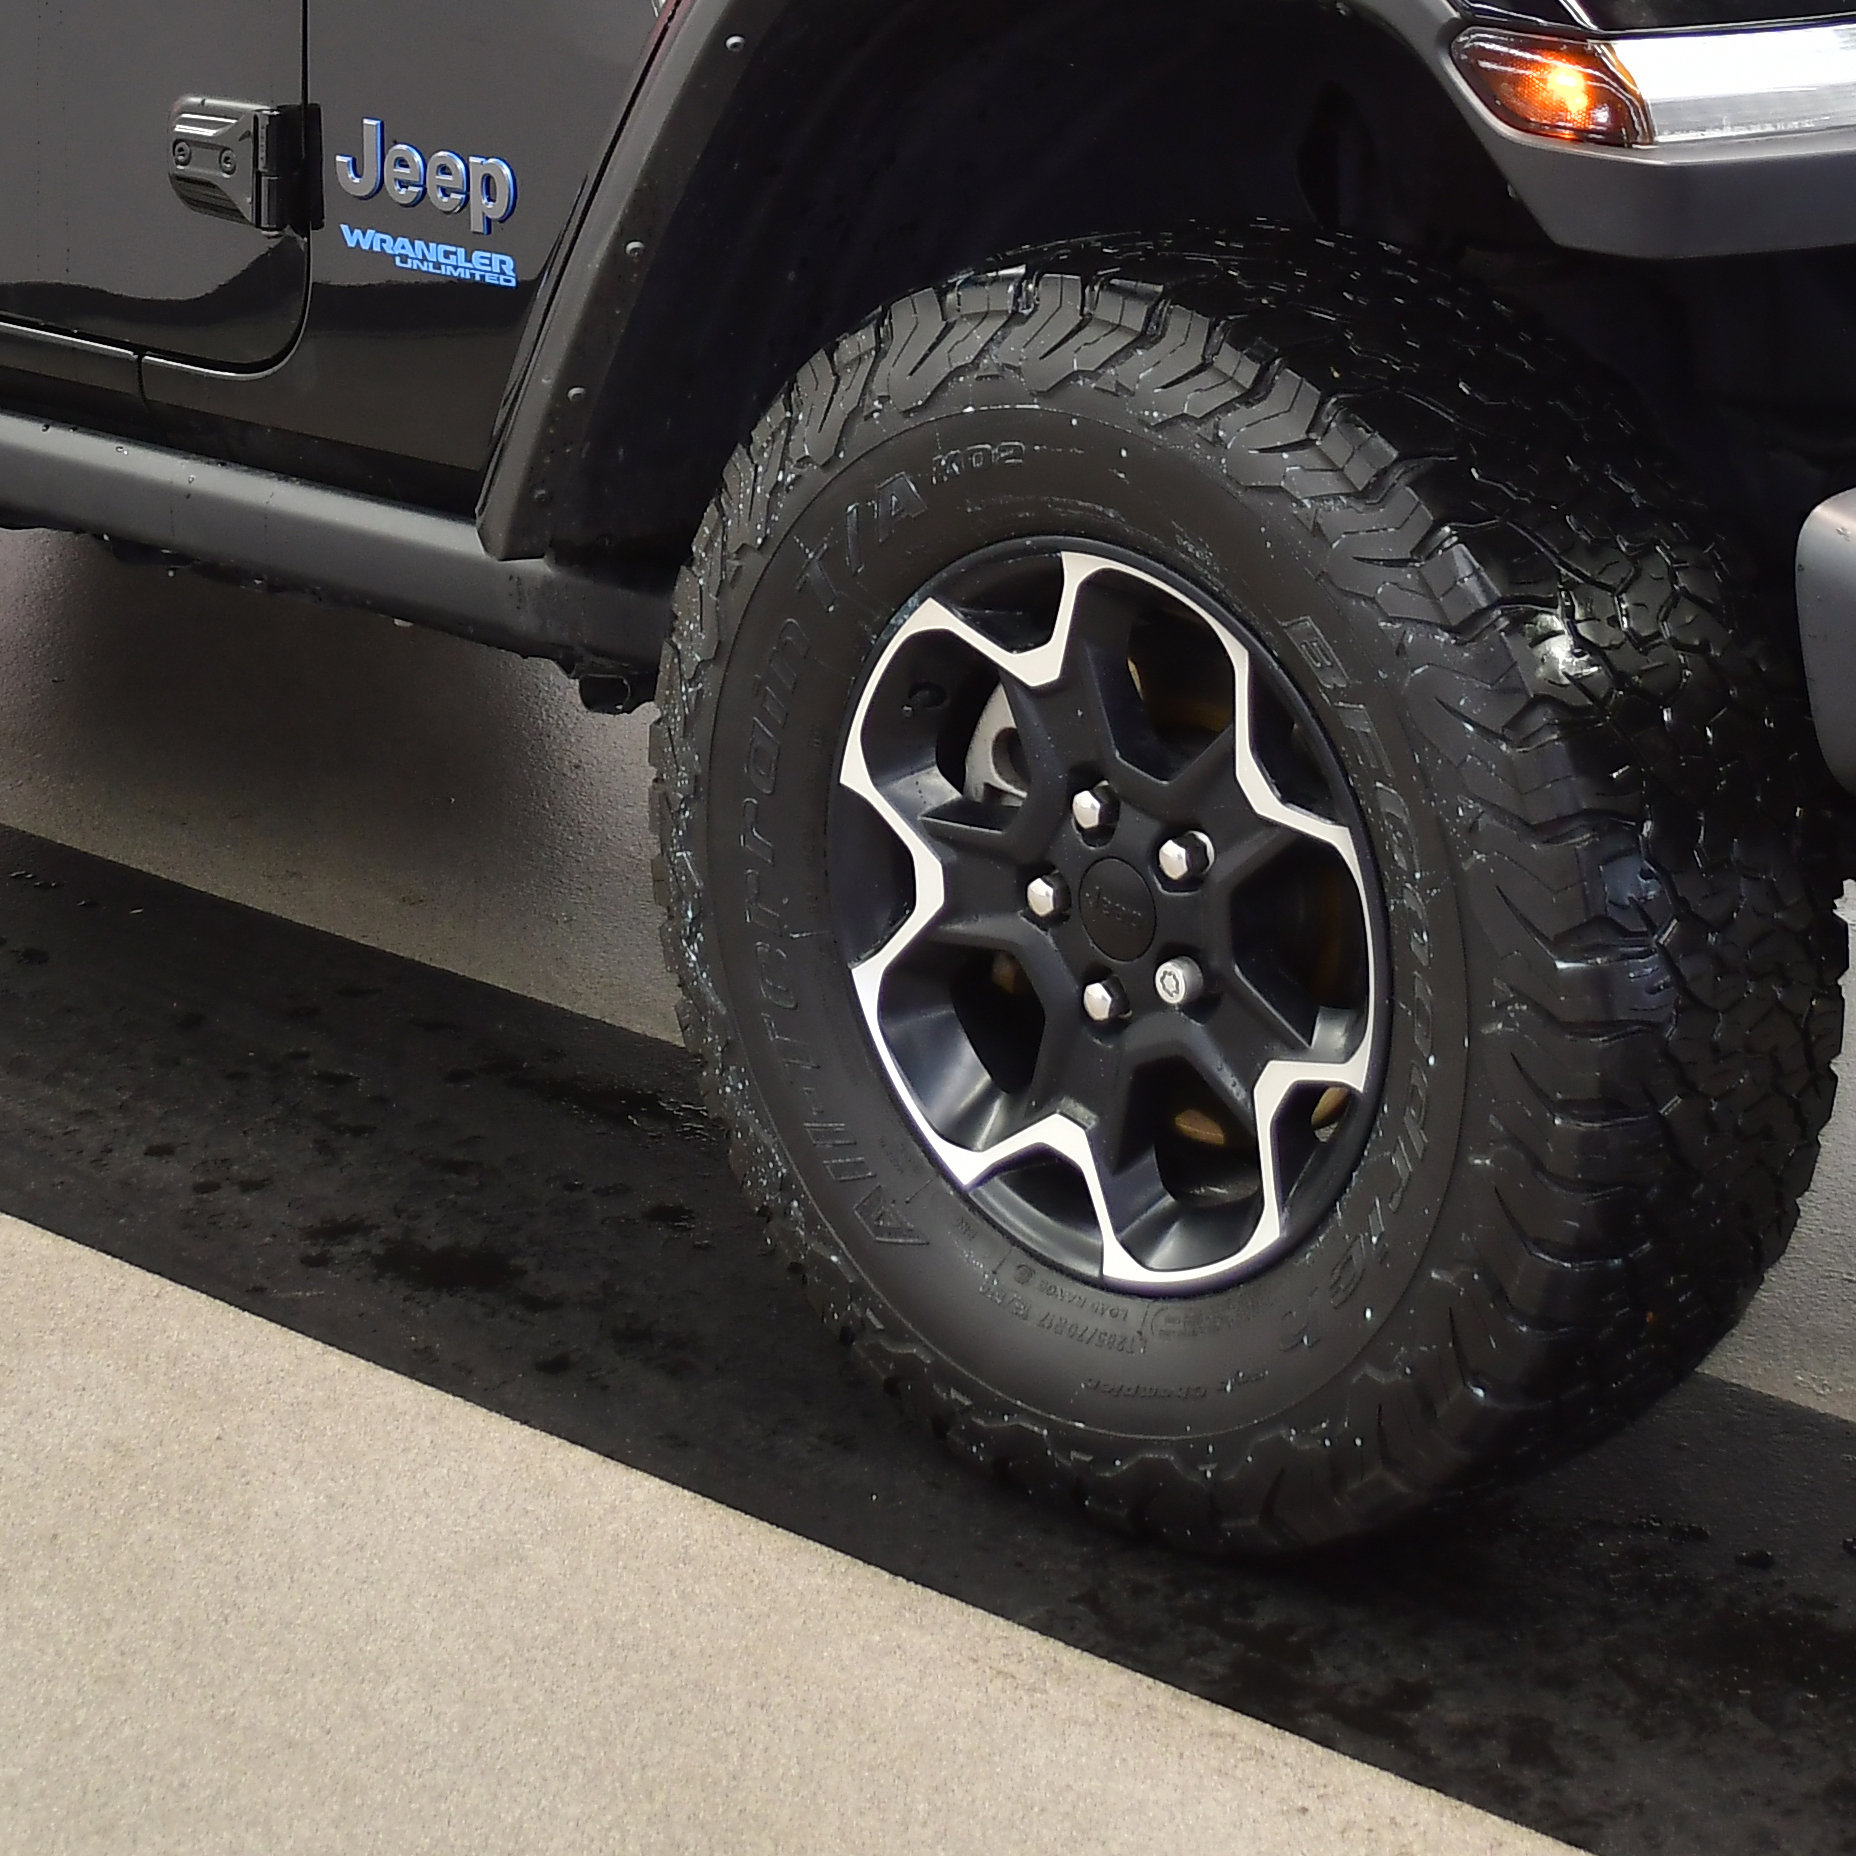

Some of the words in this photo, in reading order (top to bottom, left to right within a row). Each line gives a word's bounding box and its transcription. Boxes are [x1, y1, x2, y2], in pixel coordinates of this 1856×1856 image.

[336, 117, 518, 235] Jeep
[340, 224, 517, 277] WRANGLER
[395, 255, 517, 288] UNLIMITED
